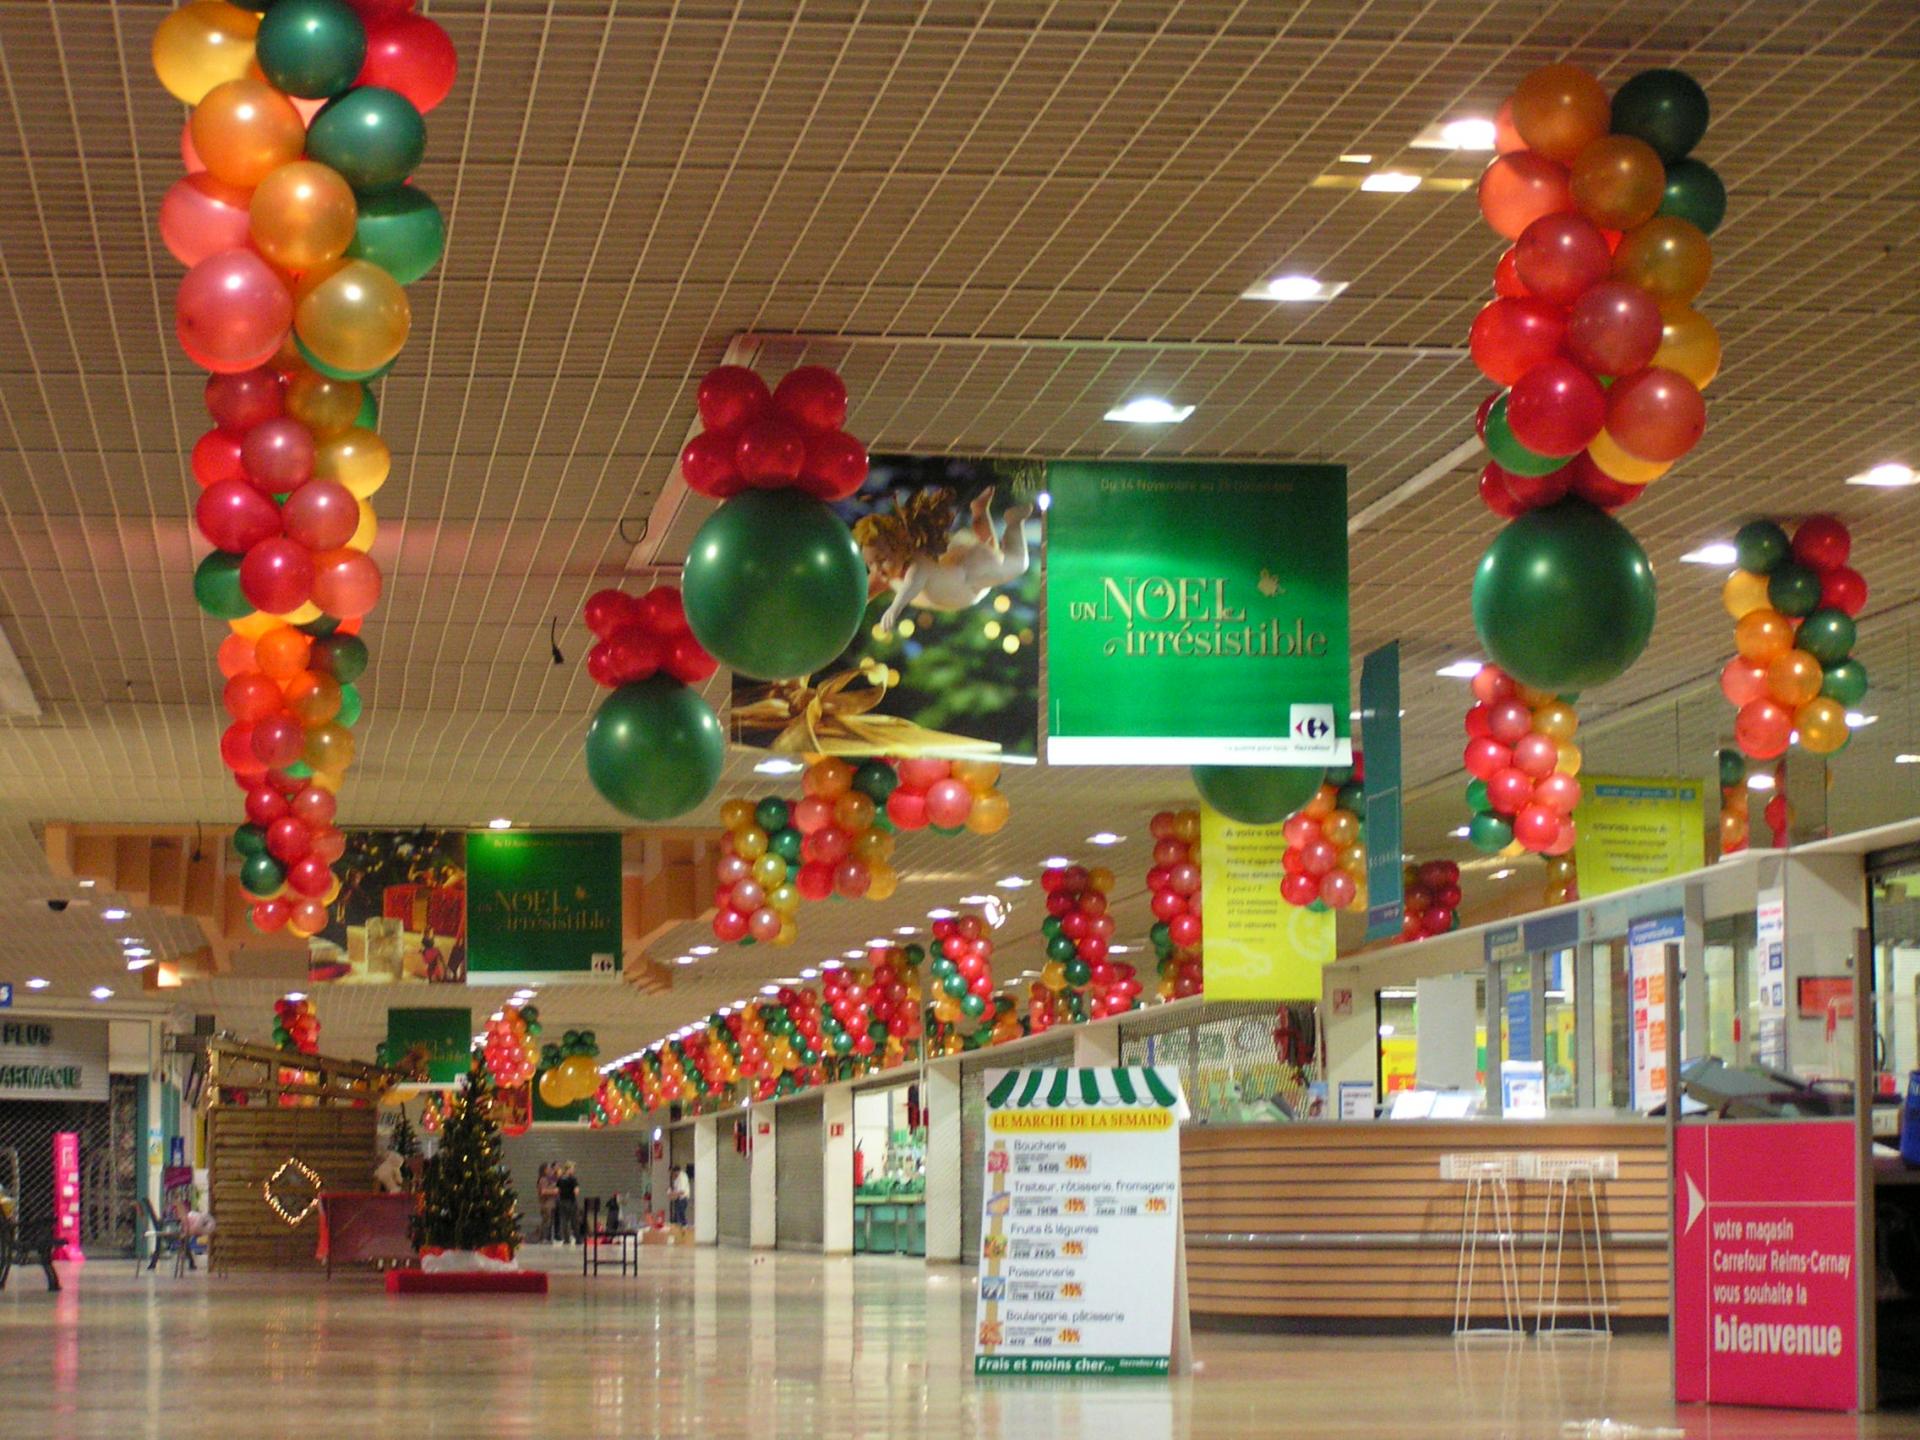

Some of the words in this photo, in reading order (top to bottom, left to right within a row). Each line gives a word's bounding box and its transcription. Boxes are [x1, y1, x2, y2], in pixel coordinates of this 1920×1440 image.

[1069, 601, 1098, 621] UN
[1100, 575, 1246, 623] NOEL
[1103, 617, 1328, 658] irrésistible
[1014, 1140, 1066, 1151] Boucherie
[1713, 1220, 1742, 1240] votre
[1746, 1217, 1793, 1246] magasin
[1713, 1249, 1767, 1272] Carrefour
[1713, 1283, 1740, 1304] vous
[1744, 1281, 1793, 1305] souhaite
[1796, 1283, 1807, 1306] la
[1714, 1314, 1842, 1356] bienvenue
[978, 1358, 1010, 1371] Frais
[1013, 1359, 1029, 1371] et
[1031, 1358, 1071, 1371] moins
